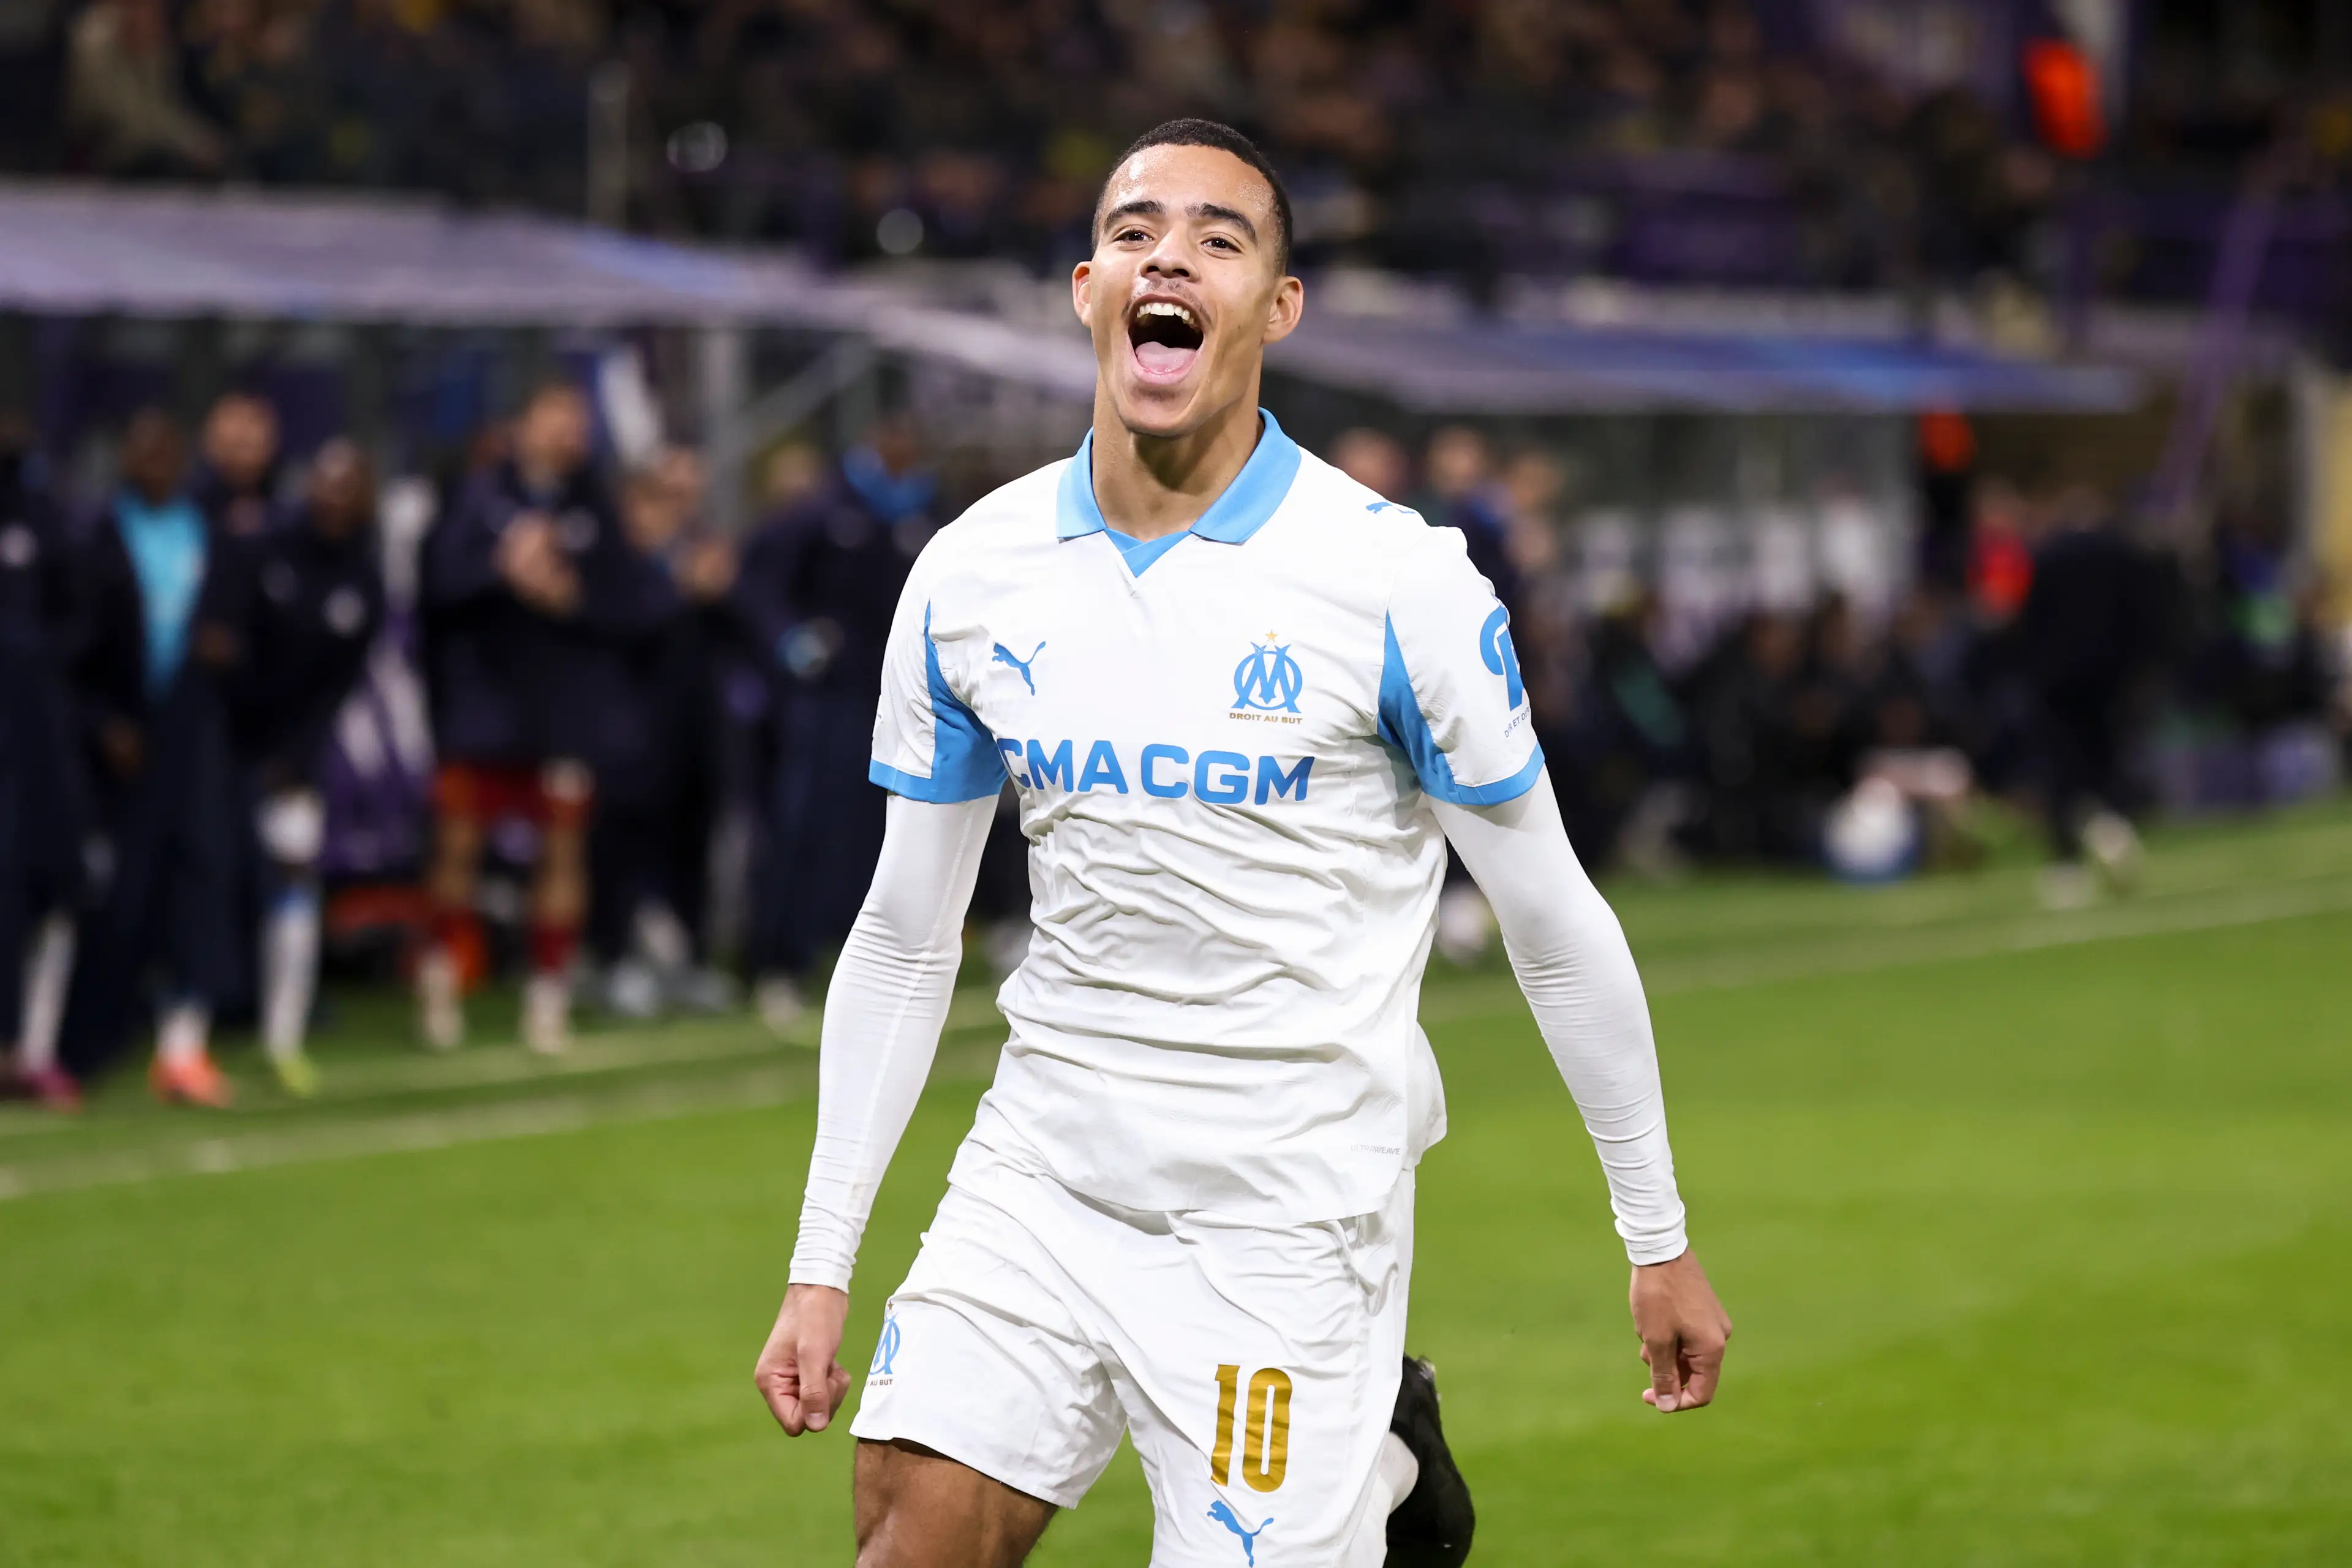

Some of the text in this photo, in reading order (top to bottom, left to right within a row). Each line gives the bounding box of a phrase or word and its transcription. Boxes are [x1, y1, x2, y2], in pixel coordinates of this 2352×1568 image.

[1229, 712, 1262, 721] DROIT
[1140, 743, 1315, 805] CGM
[1351, 1144, 1401, 1155] ULTRAWEAVE
[1210, 1364, 1292, 1493] 10
